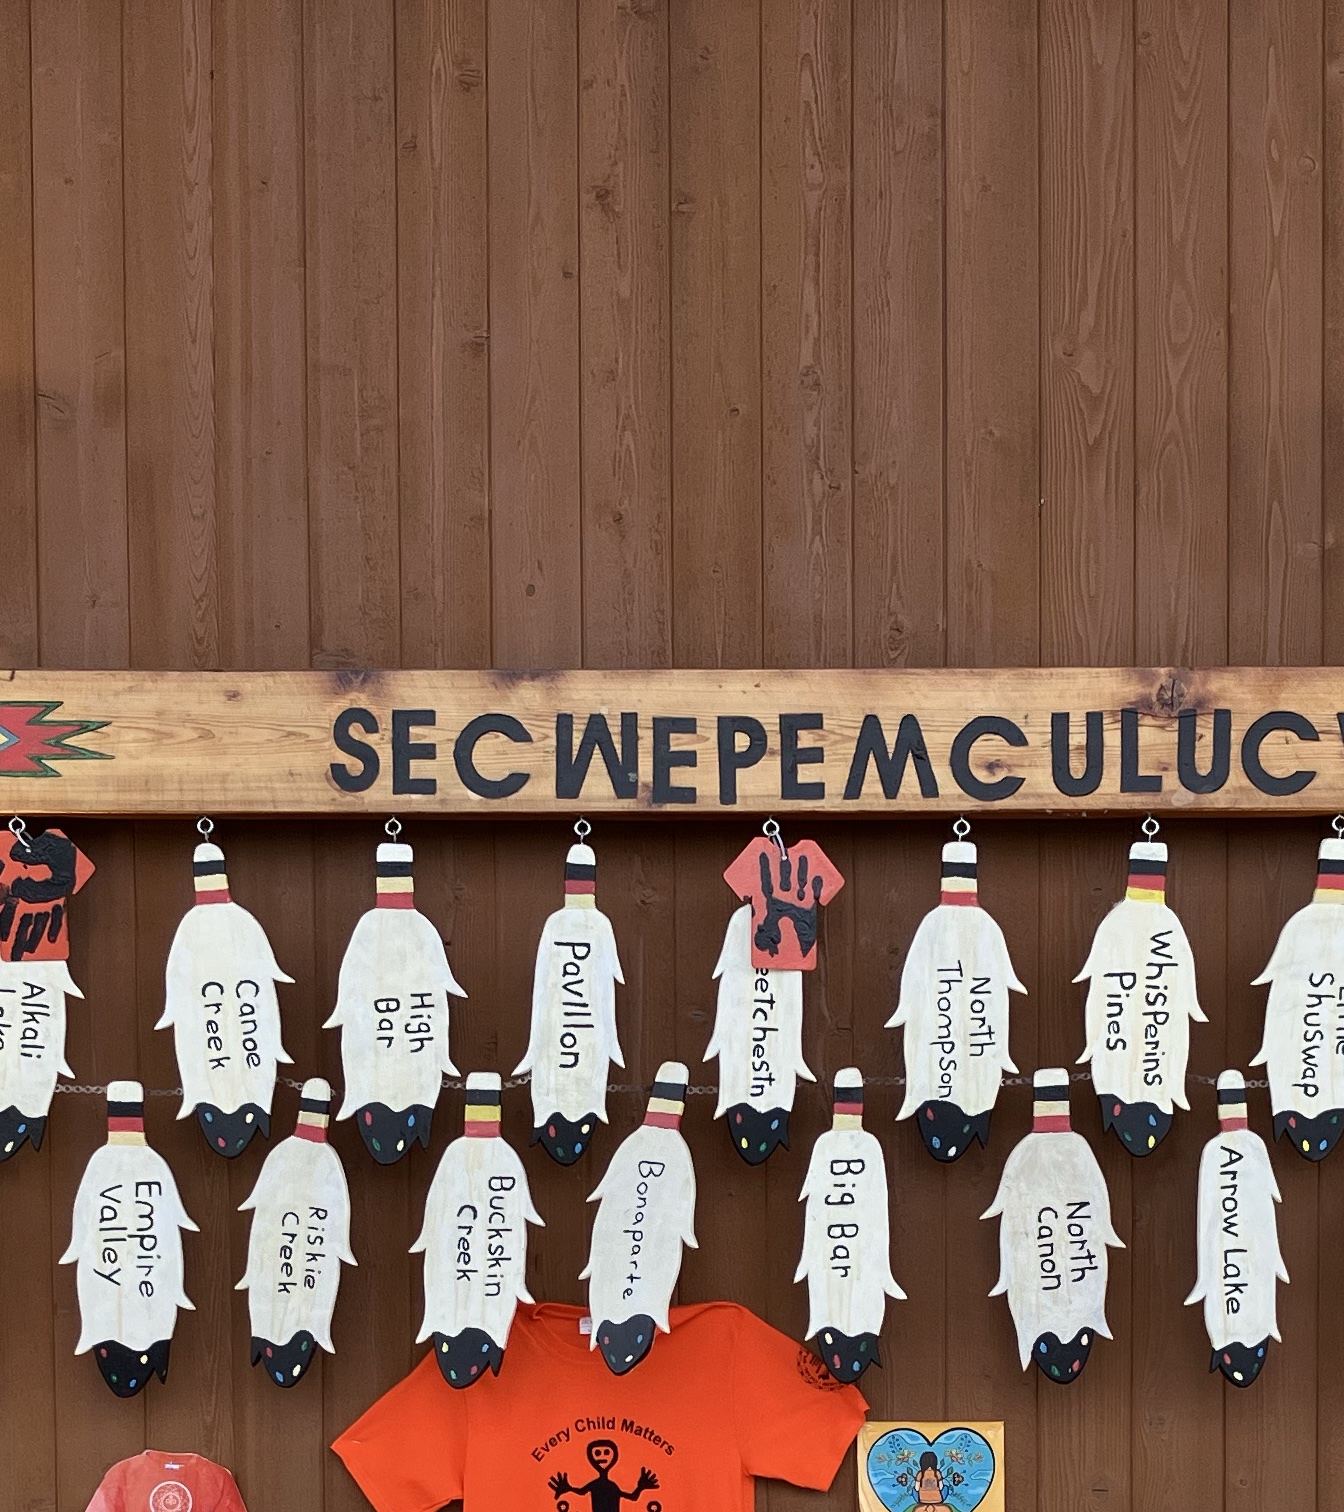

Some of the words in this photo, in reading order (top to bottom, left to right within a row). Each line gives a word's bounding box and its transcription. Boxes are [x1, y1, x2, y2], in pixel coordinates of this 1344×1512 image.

[19, 981, 51, 1059] Alkali
[201, 981, 231, 1070] Creek
[235, 979, 261, 1068] Canoe
[373, 997, 401, 1049] Bar
[404, 992, 435, 1053] High
[750, 968, 779, 1097] eetchestn
[930, 959, 964, 1099] Thompson
[968, 977, 996, 1057] North
[1103, 972, 1137, 1051] Pines
[1292, 972, 1336, 1098] Shuswap
[824, 1158, 866, 1206] Big
[1219, 1145, 1244, 1234] Arrow
[93, 1184, 128, 1286] Valley
[127, 1181, 162, 1298] Empire
[277, 1211, 300, 1294] Creek
[303, 1206, 328, 1290] Riskie
[456, 1204, 479, 1282] Creek
[484, 1176, 516, 1297] Buckskin
[622, 1160, 666, 1300] Bonaparte
[827, 1223, 859, 1278] Bar
[1036, 1206, 1062, 1291] Canon
[1066, 1201, 1099, 1283] North
[1222, 1236, 1250, 1315] Lake
[531, 1427, 571, 1463] Every
[574, 1416, 616, 1433] Child
[620, 1418, 676, 1457] Matters
